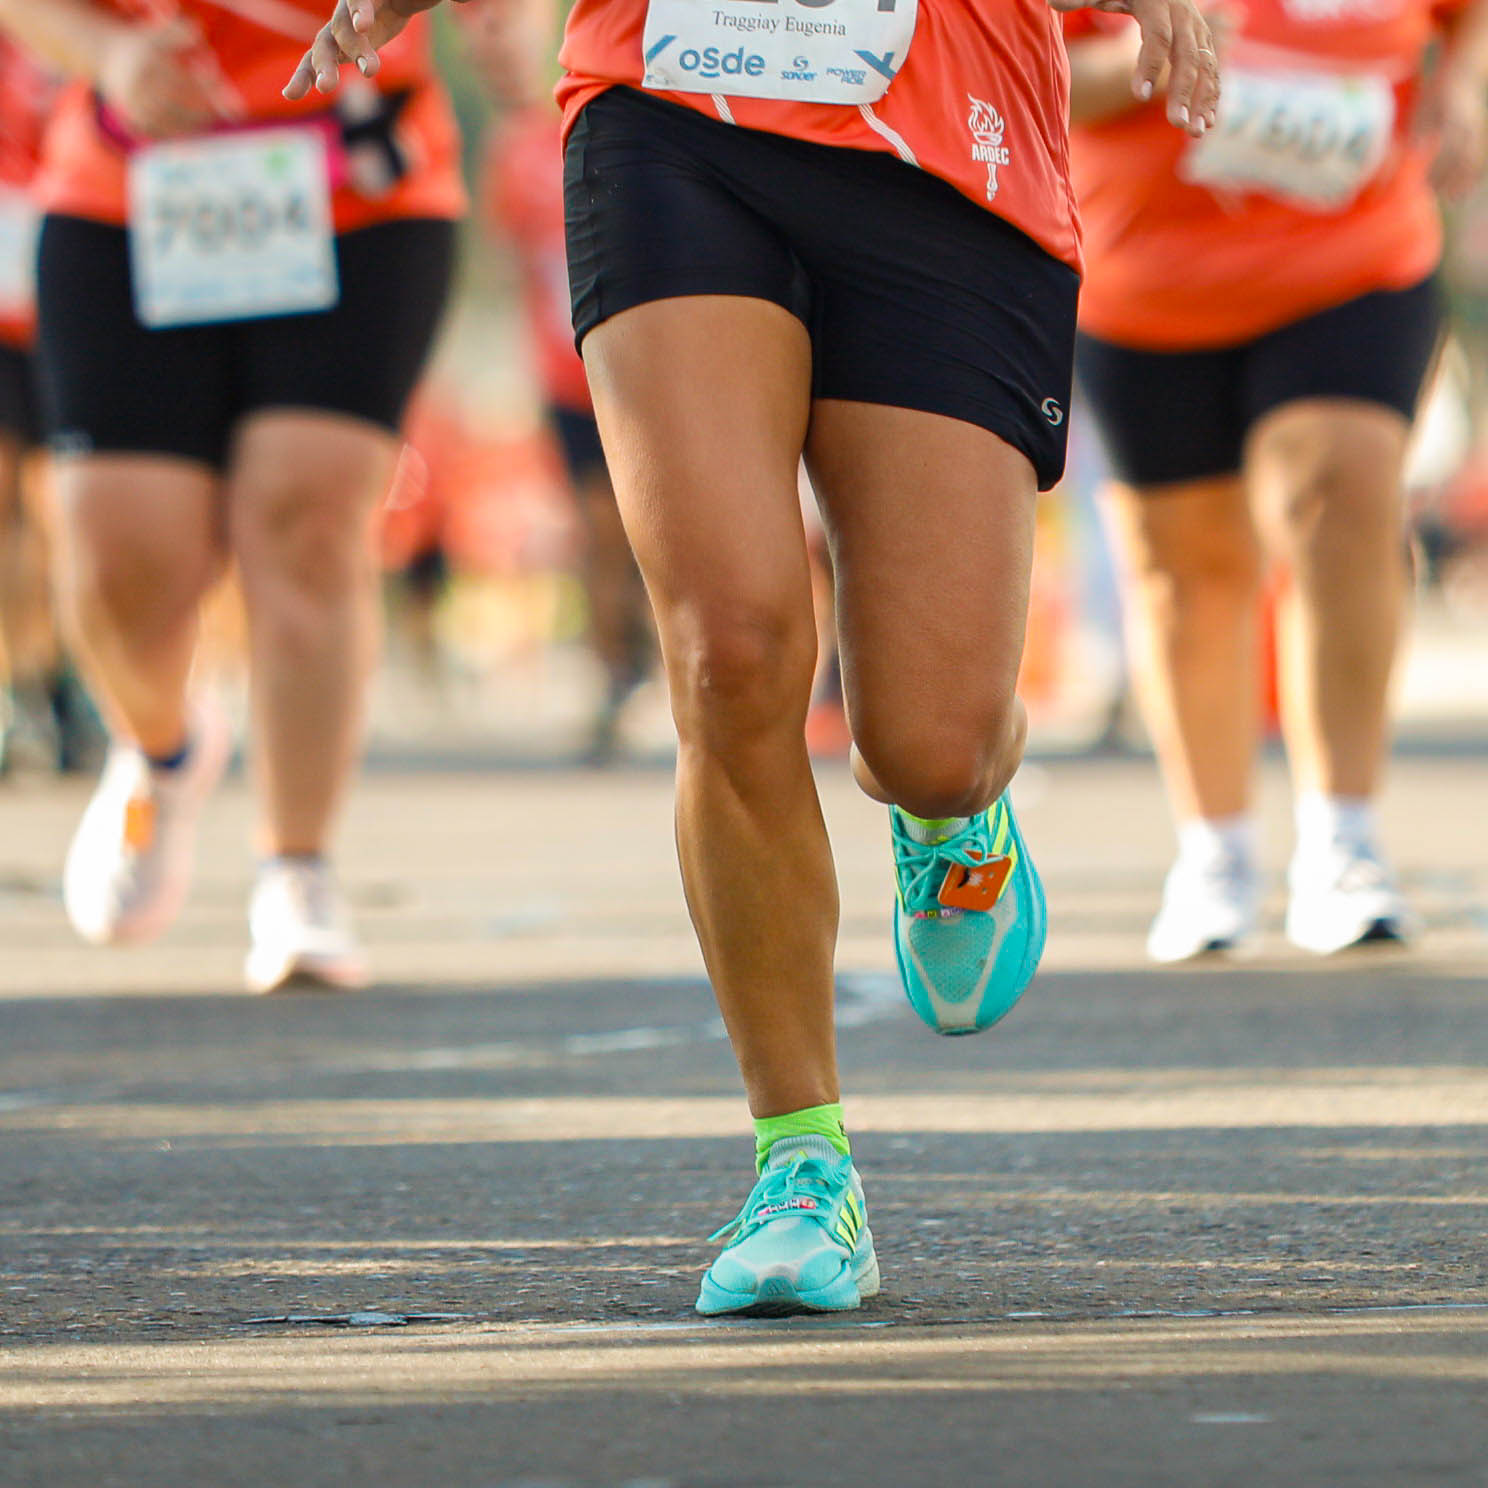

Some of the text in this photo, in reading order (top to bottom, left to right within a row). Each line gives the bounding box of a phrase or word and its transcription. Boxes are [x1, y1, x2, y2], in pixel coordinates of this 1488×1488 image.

[712, 10, 847, 37] Traggiay Eugenia
[679, 45, 766, 77] osde
[972, 143, 1010, 167] ARDEC
